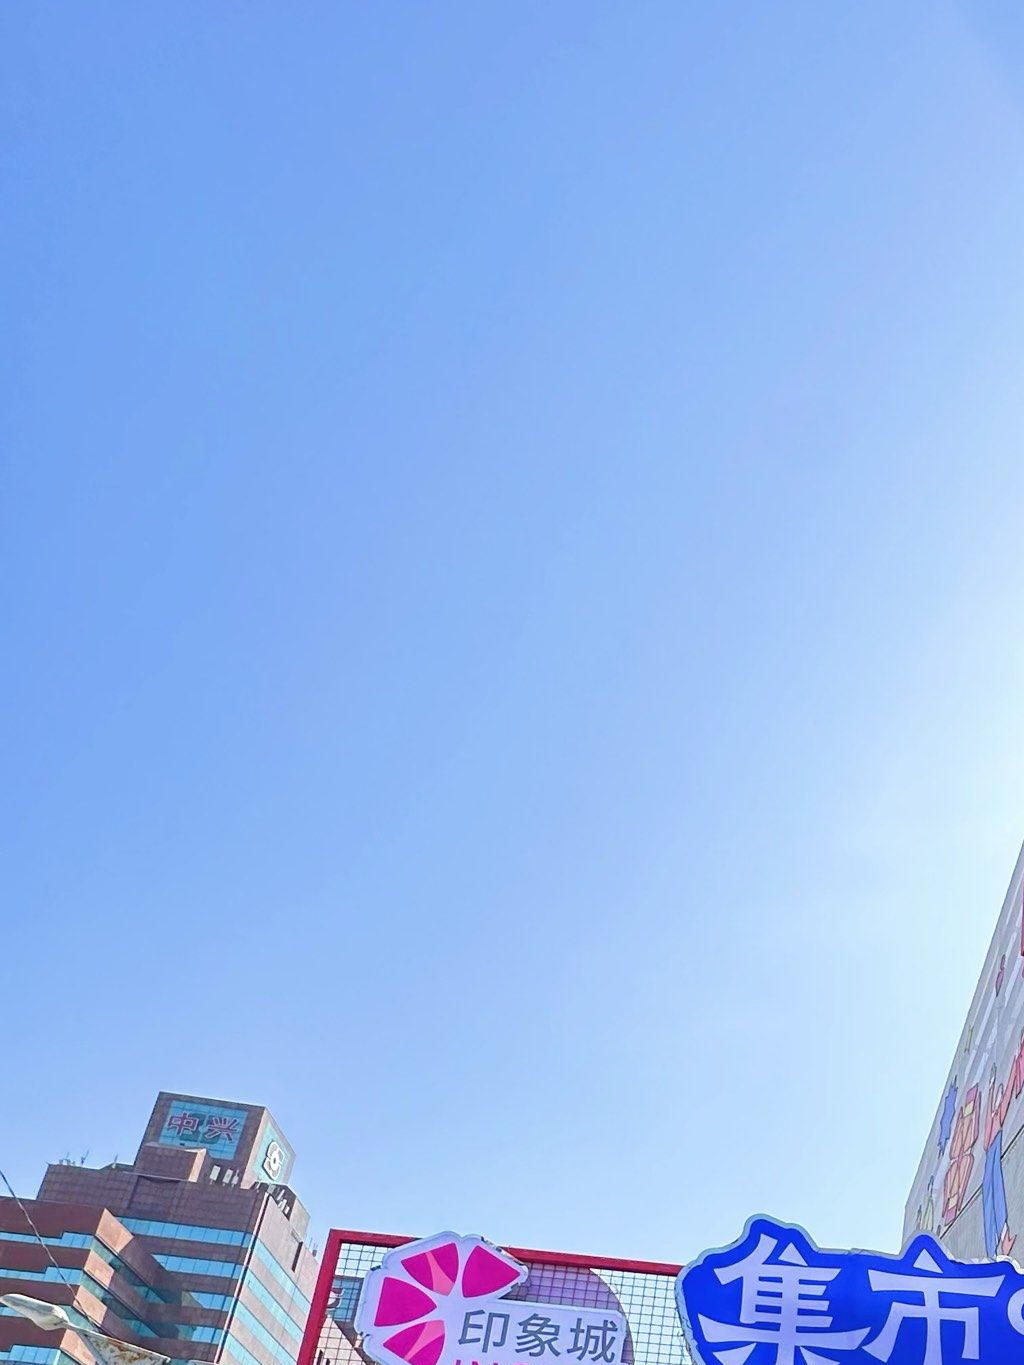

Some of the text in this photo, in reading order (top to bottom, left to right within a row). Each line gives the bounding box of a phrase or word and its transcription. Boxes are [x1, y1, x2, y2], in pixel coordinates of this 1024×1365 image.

[167, 1111, 239, 1141] 中兴
[457, 1309, 621, 1364] 印象城
